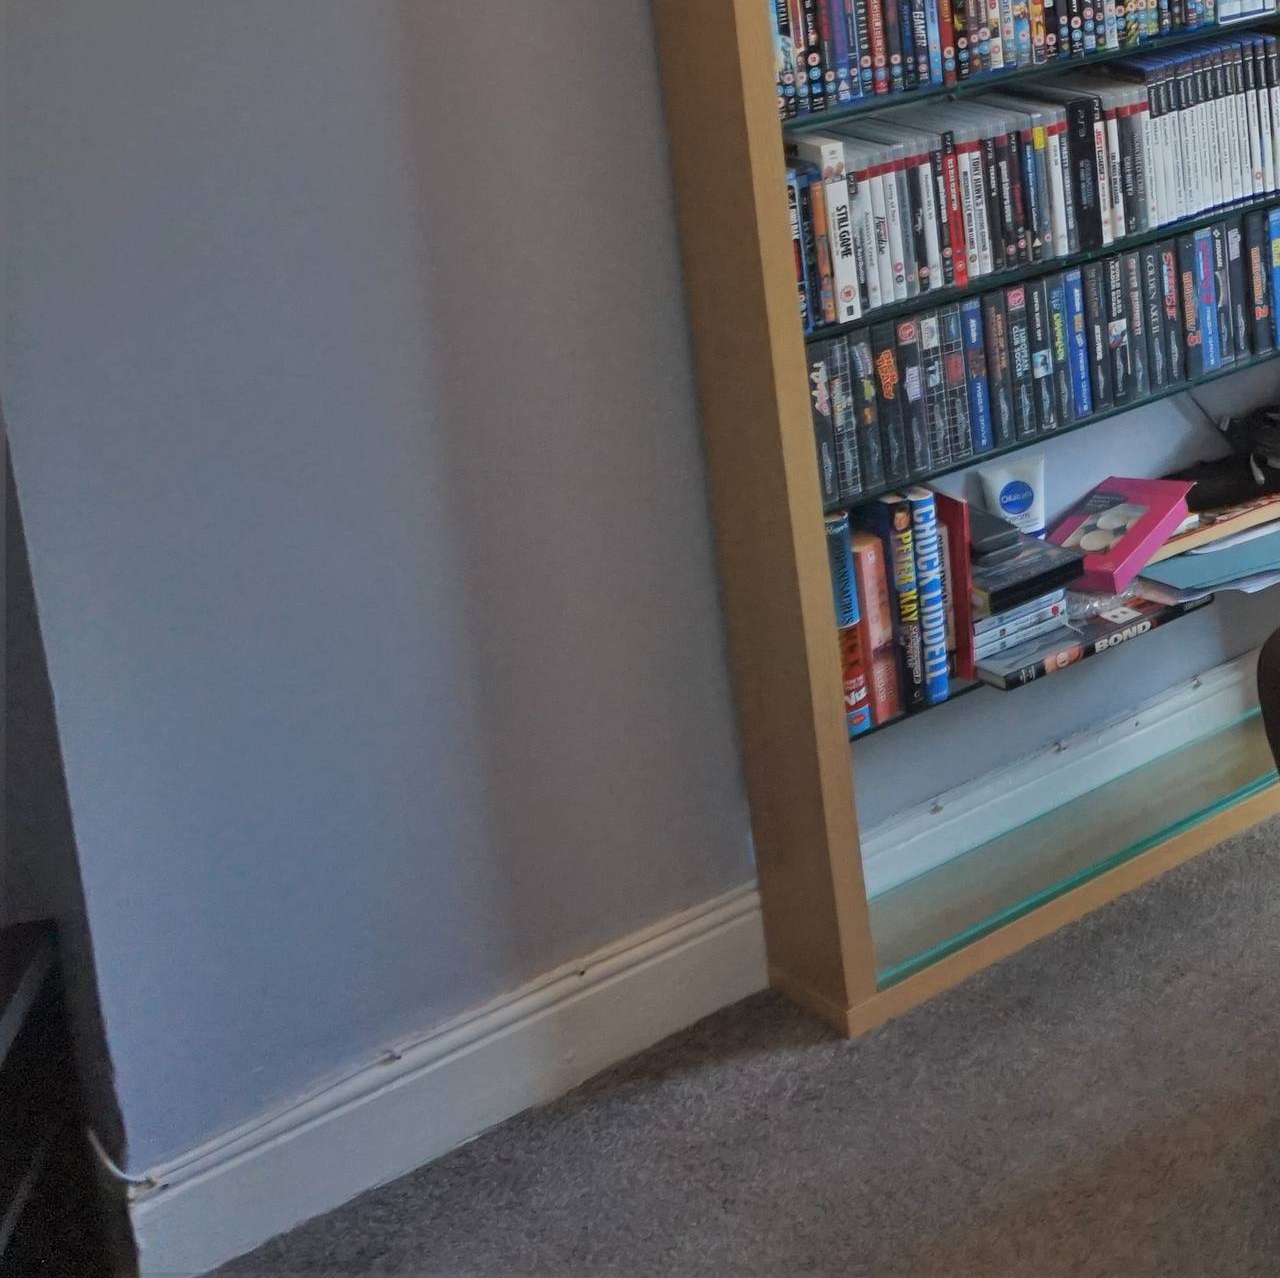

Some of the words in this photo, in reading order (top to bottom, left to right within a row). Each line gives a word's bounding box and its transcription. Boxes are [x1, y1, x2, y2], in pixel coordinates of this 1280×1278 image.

[806, 14, 815, 47] GAME
[912, 11, 926, 47] GAMER
[971, 157, 979, 176] TONY
[974, 178, 982, 207] HAWK'S
[835, 205, 848, 228] STILL
[863, 212, 872, 244] Assassin's
[840, 230, 852, 259] GAME
[875, 216, 886, 255] Paradise
[857, 247, 866, 284] Retribution
[1146, 255, 1157, 300] GOLDEN
[1150, 303, 1158, 323] AXE
[1152, 326, 1159, 334] II
[1014, 348, 1022, 377] SOCCER
[1020, 328, 1029, 371] EUROPEAN
[895, 529, 917, 589] PETER
[913, 504, 940, 587] CHUCK
[899, 589, 921, 624] KAY
[920, 592, 947, 686] LIDDELL
[1095, 620, 1152, 653] BOND
